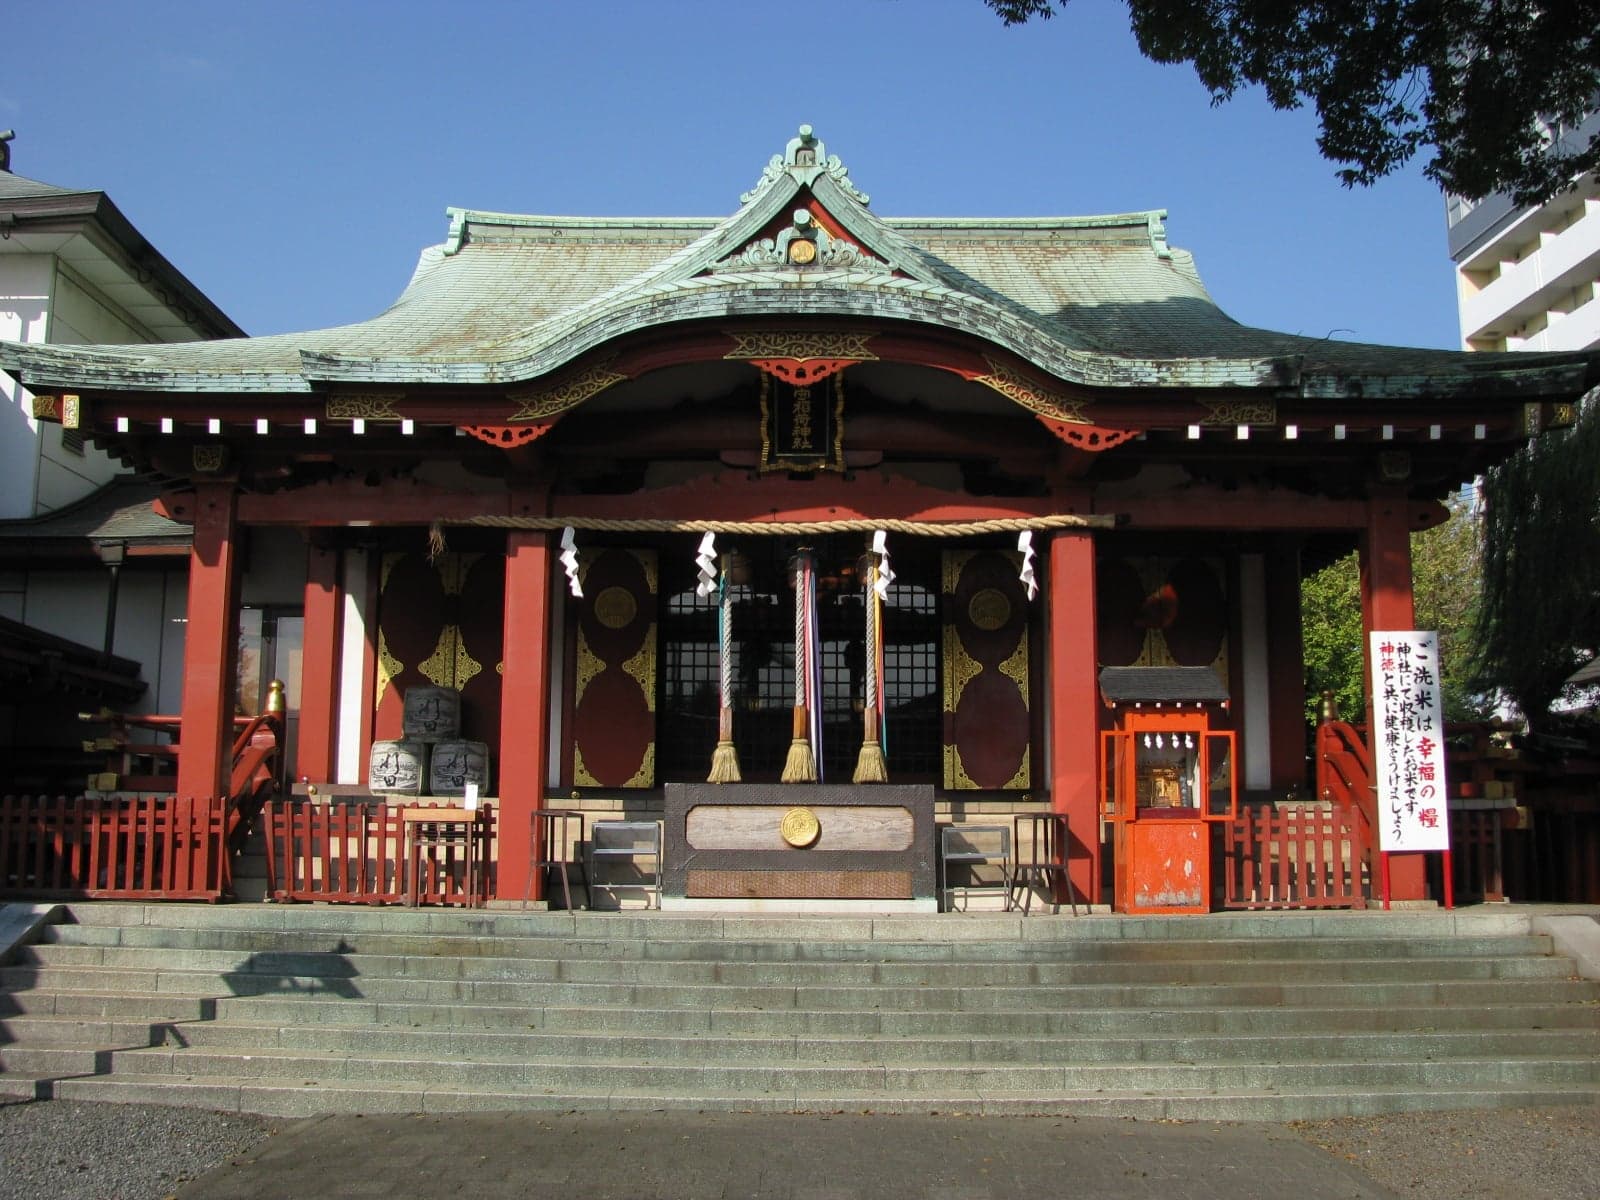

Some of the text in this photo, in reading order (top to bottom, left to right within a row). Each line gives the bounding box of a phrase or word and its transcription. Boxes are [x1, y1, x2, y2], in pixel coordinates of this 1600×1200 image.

[1397, 642, 1419, 817] 神社にて収穫したお米です
